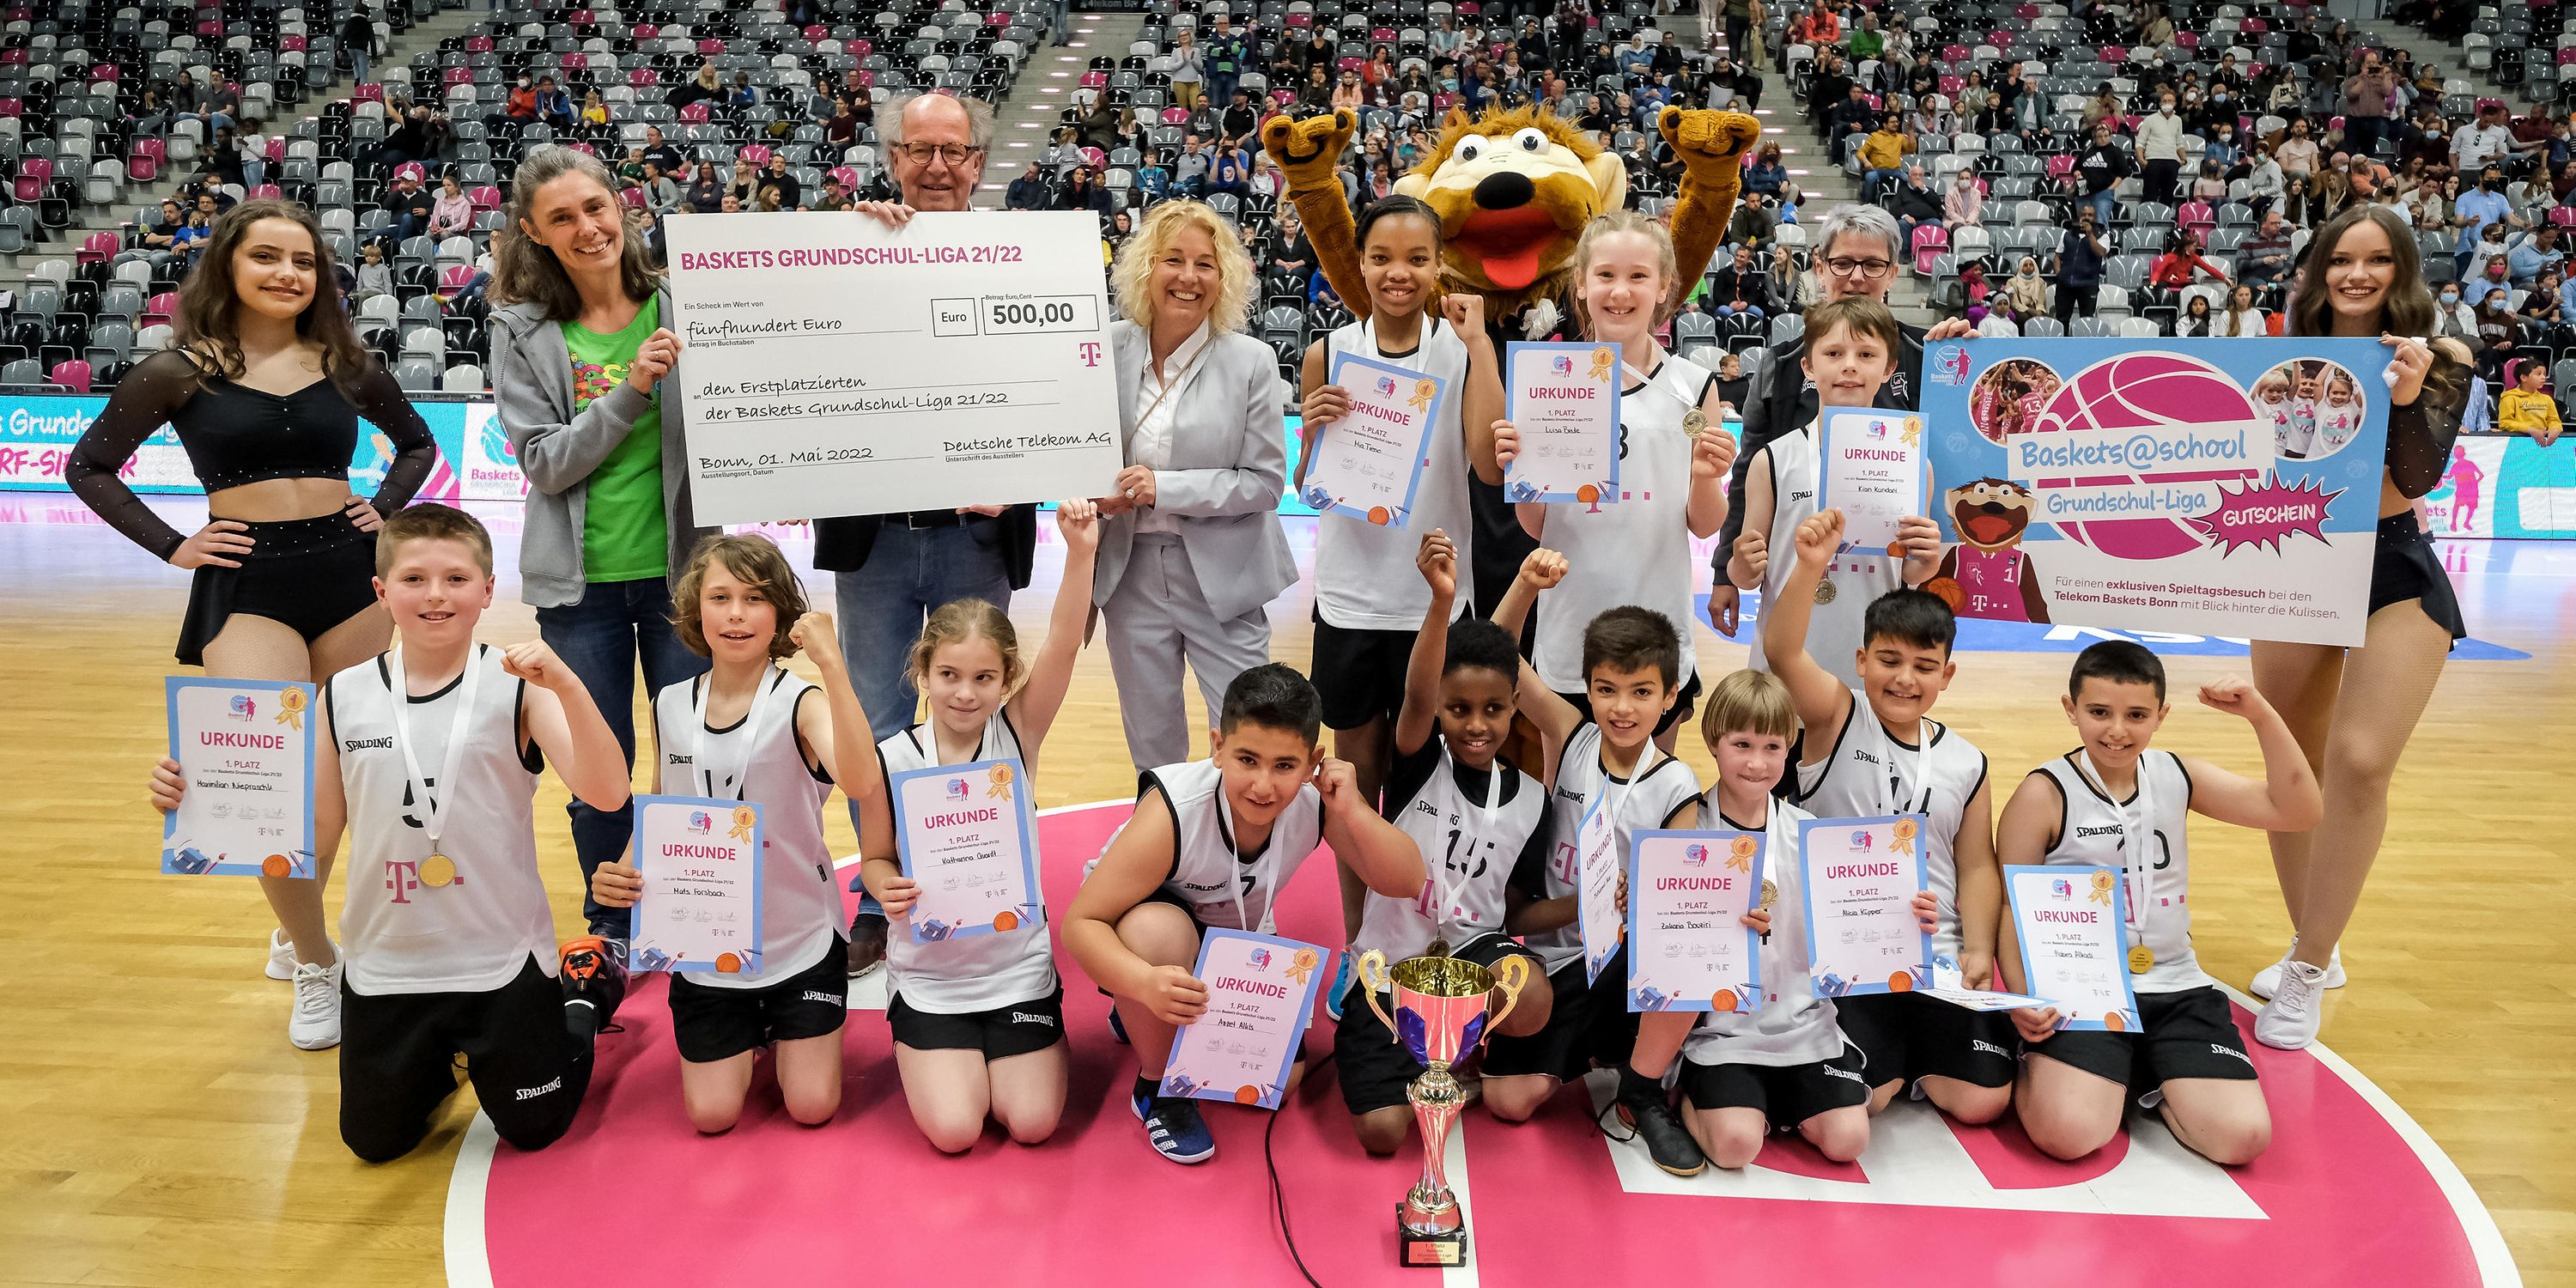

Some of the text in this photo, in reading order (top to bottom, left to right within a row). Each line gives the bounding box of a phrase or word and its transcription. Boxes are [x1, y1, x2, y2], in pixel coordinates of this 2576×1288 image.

[681, 246, 1023, 270] BASKETS GRUNDSCHUL-LIGA 21/22
[941, 312, 967, 323] Euro
[993, 303, 1074, 327] 500,00
[686, 318, 842, 340] fünfhundert Euro
[717, 338, 755, 347] Buchstaben
[702, 375, 866, 397] den Erstplatzierten
[1529, 387, 1595, 399] URKUNDE
[705, 392, 1009, 421] der Baskets Grundschul-Liga 21/22
[1349, 399, 1411, 427] URKUNDE
[2024, 400, 2042, 414] 13
[1368, 427, 1388, 437] PLATZ
[943, 432, 1112, 452] Deutsche Telekom AG
[2020, 429, 2246, 471] Baskets@school
[699, 447, 874, 470] Bonn, 01. Mai 2022
[945, 454, 981, 463] Unterschrift
[1844, 448, 1906, 462] URKUNDE
[471, 468, 519, 481] Baskets
[701, 470, 752, 479] Ausstellungsort,
[2047, 489, 2208, 513] Grundschul-Liga
[2222, 503, 2317, 526] GUTSCHEIN
[2003, 568, 2014, 583] 1
[2055, 576, 2312, 602] Für einen exklusiven Spieltagsbesuch bei den
[2054, 591, 2341, 620] Telekom Baskets Bonn mit Blick hinter die Kulissen.
[201, 732, 284, 750] URKUNDE
[344, 736, 392, 752] SPALDING
[234, 760, 260, 769] PLATZ
[1557, 786, 1585, 805] SPALDING
[924, 808, 999, 829] URKUNDE
[957, 834, 979, 844] PLATZ
[2076, 824, 2123, 837] SPALDING
[662, 844, 736, 861] URKUNDE
[1586, 829, 1612, 871] URKUNDE
[691, 869, 714, 878] PLATZ
[1826, 862, 1899, 879] URKUNDE
[1184, 880, 1228, 891] SPALDING
[1656, 877, 1732, 890] URKUNDE
[2034, 910, 2098, 923] URKUNDE
[1216, 976, 1287, 999] URKUNDE
[802, 989, 841, 1006] SPALDING
[1236, 1003, 1260, 1013] PLATZ
[1012, 1012, 1054, 1027] SPALDING
[1823, 1064, 1864, 1084] SPALDING
[515, 1077, 561, 1101] SPALDING
